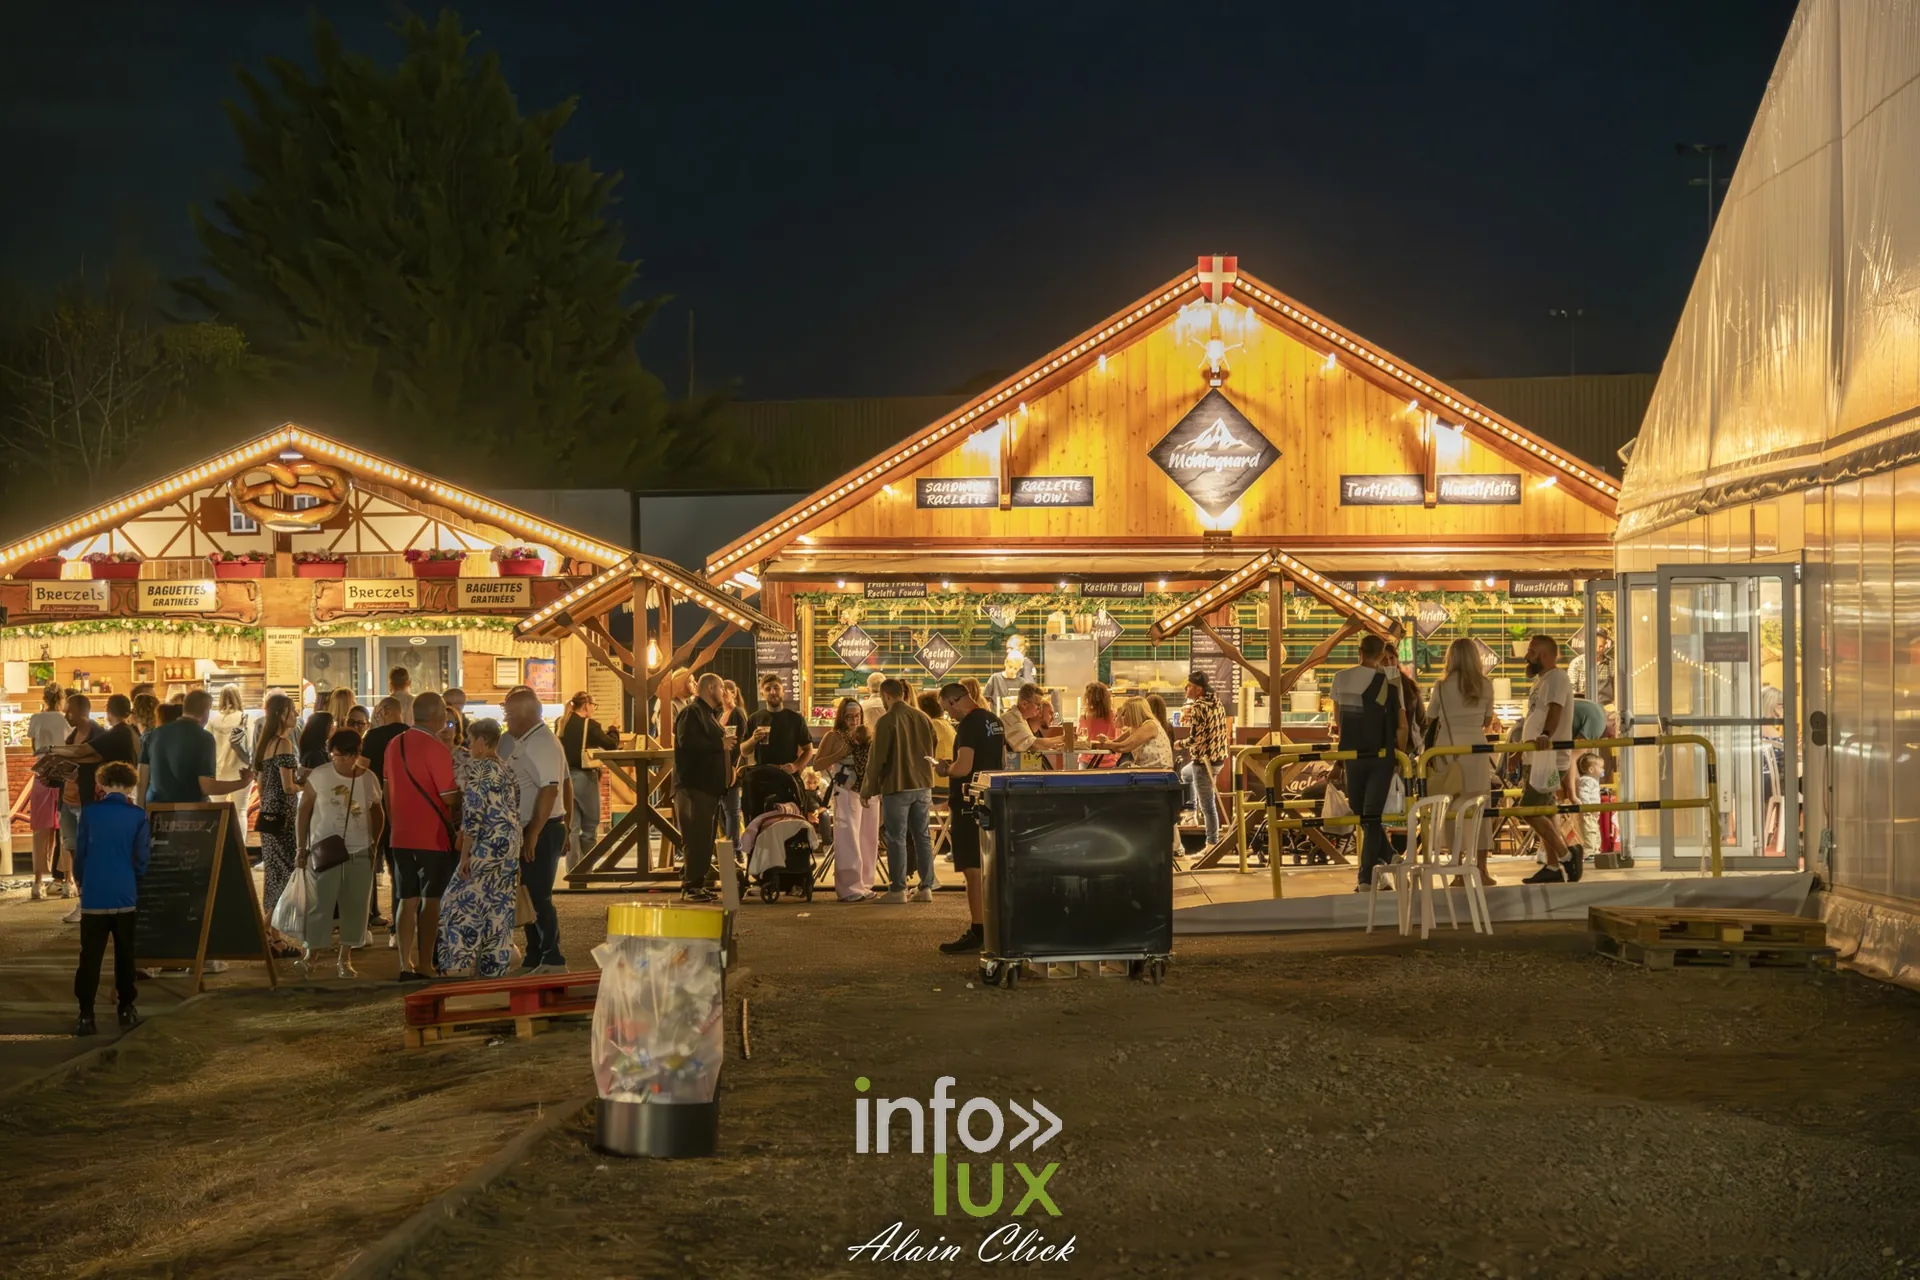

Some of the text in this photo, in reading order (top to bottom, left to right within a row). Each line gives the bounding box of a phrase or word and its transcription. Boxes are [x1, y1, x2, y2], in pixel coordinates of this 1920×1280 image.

[1168, 451, 1261, 472] Montagnard
[1021, 480, 1083, 491] RACLETTE
[1345, 479, 1418, 499] Tartiflette
[1440, 479, 1517, 499] Munstiflette
[926, 493, 988, 505] RACLETTE
[1034, 492, 1069, 504] BOWL
[147, 584, 206, 596] BAGUETTES
[348, 585, 415, 599] Bretzels
[465, 582, 523, 593] BAGUETTES
[1084, 582, 1143, 592] Raclette Bowl
[1514, 582, 1569, 594] Munstiflette
[35, 586, 105, 601] Bretzels
[898, 589, 925, 597] Fondue
[152, 597, 199, 606] GRATINÉES
[470, 594, 516, 604] GRATINÉES
[837, 637, 870, 648] Sandwich
[840, 647, 870, 657] Morbier
[922, 647, 955, 658] Raclette
[928, 659, 949, 670] Bowl
